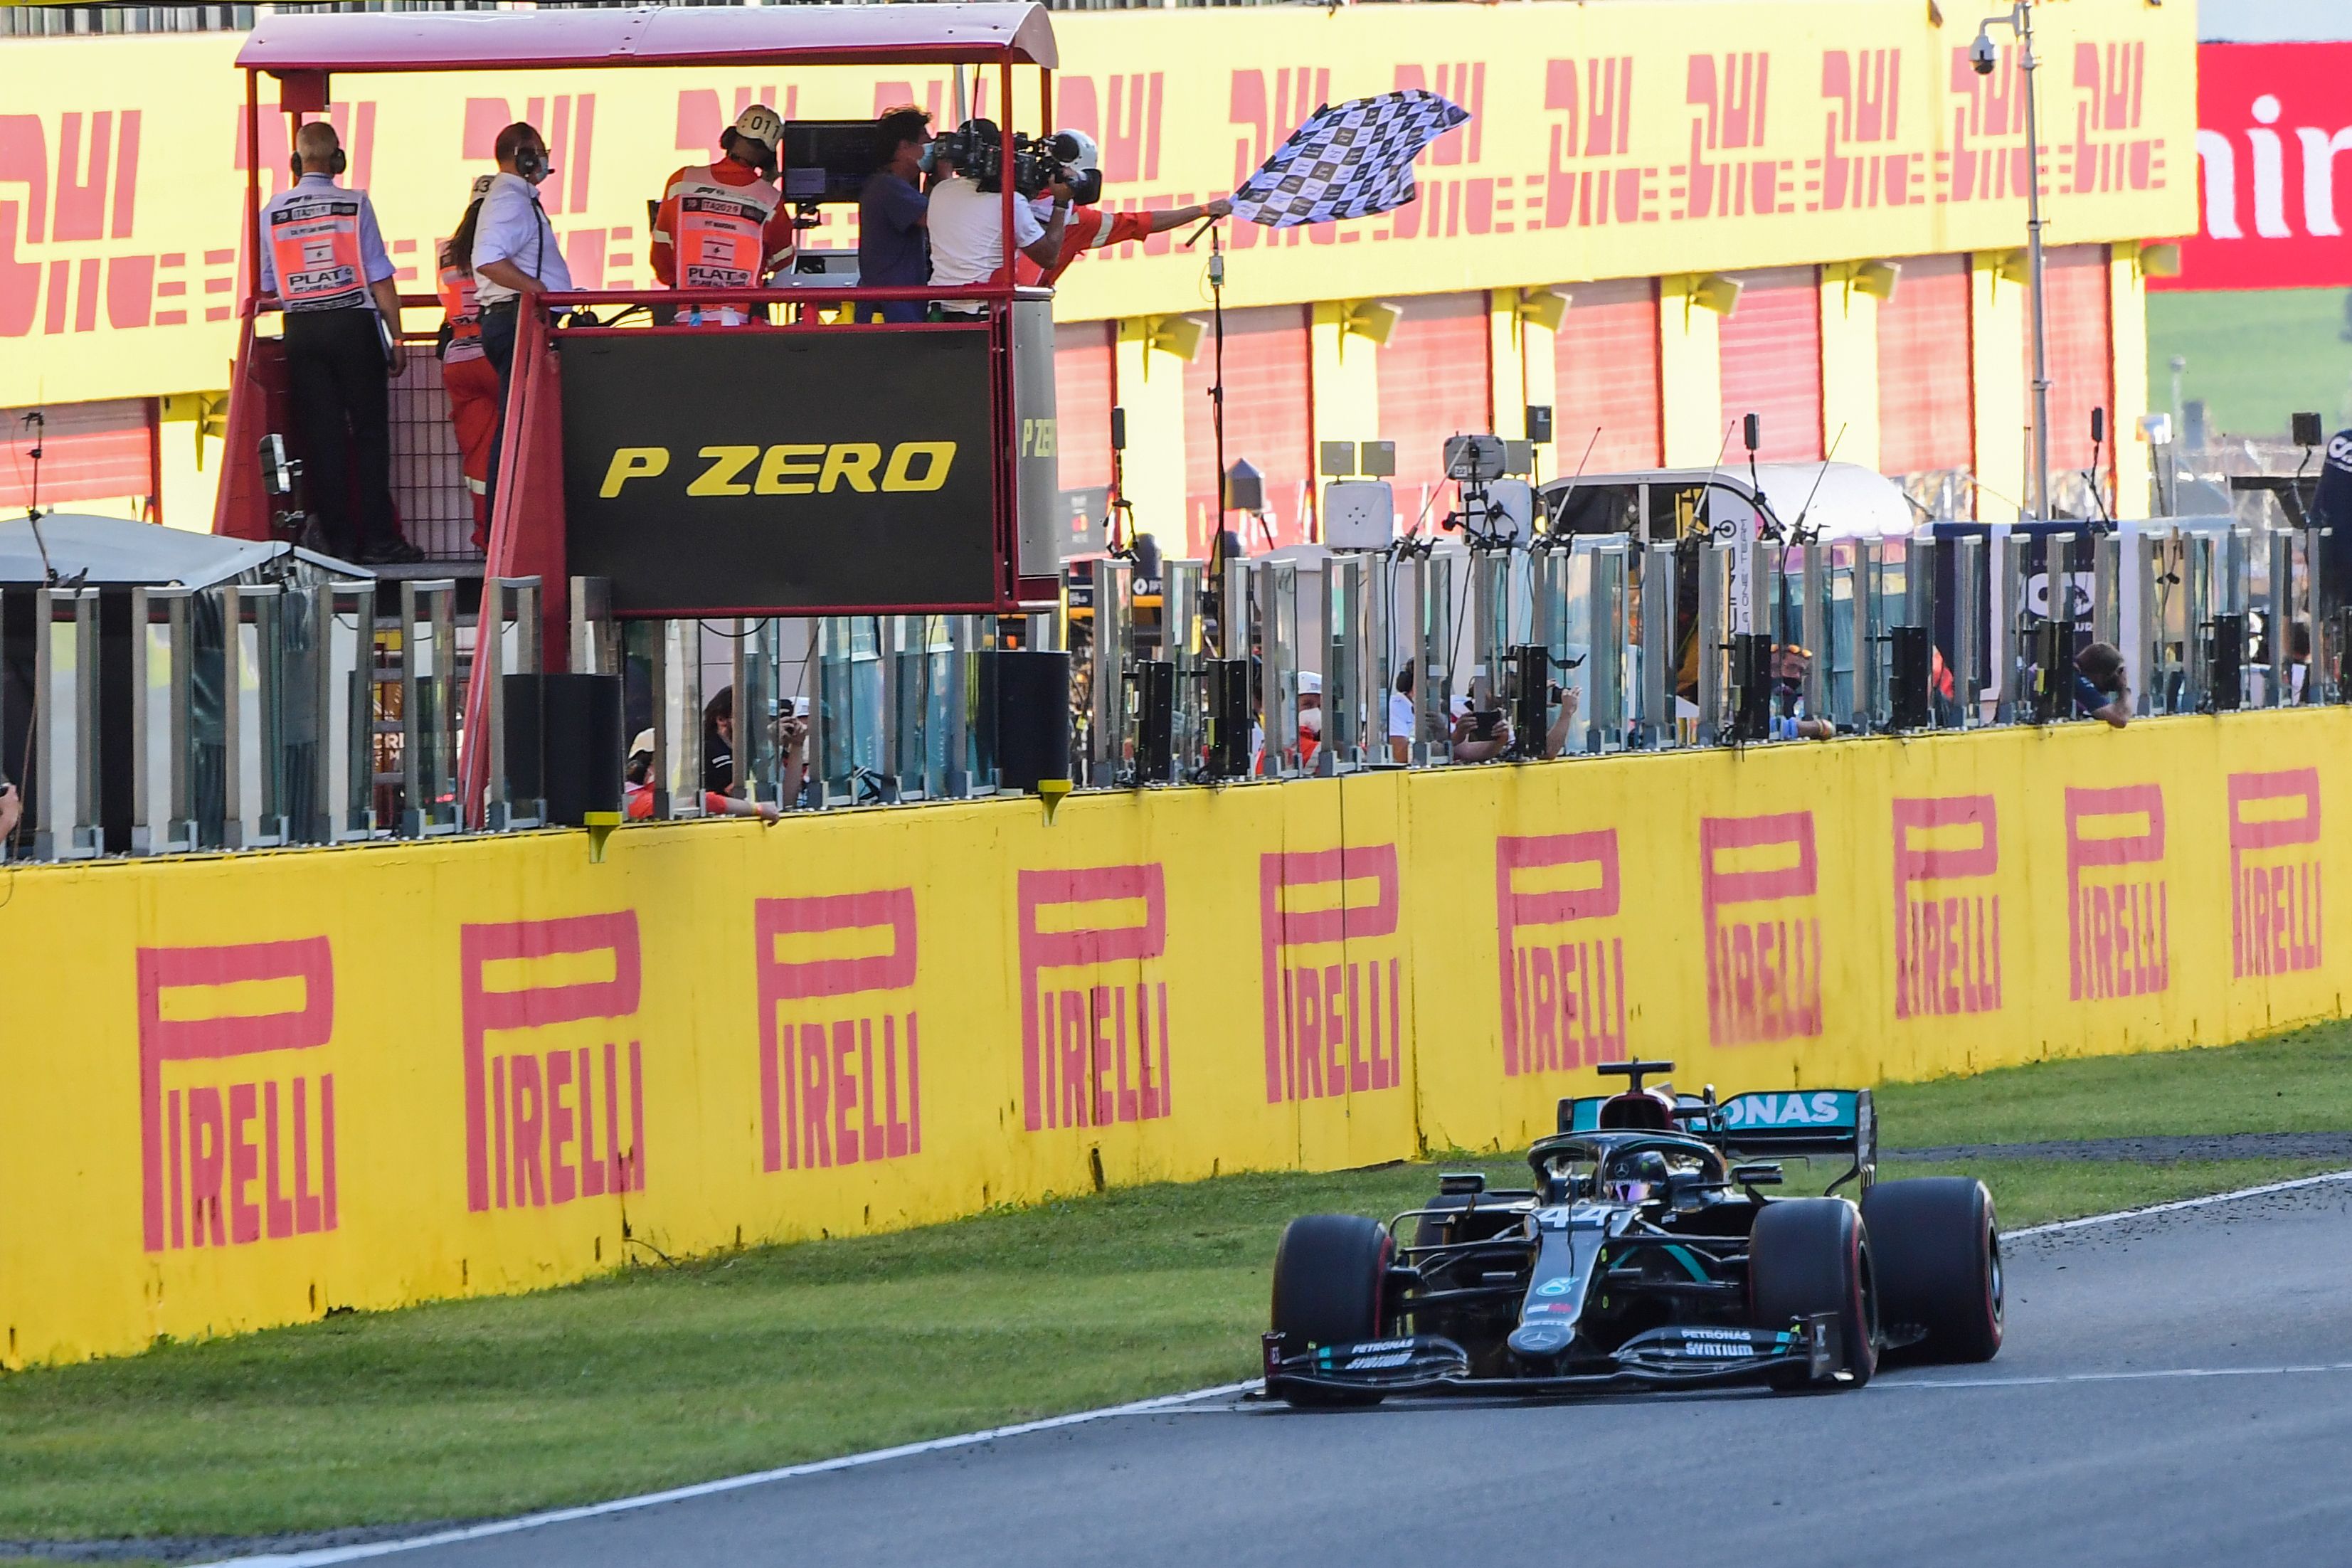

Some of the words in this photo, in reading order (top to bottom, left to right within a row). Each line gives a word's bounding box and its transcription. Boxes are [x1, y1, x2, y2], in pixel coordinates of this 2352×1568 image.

[751, 116, 780, 139] 011
[290, 269, 342, 286] PLAT
[689, 267, 737, 280] PLAT
[600, 447, 670, 498] P
[687, 442, 957, 497] ZERO
[1260, 843, 1400, 1103] PIRELLI
[1497, 828, 1625, 1076] PIRELLI
[1700, 810, 1823, 1047] PIRELLI
[1893, 794, 2001, 1019] PIRELLI
[2065, 783, 2168, 1000] PIRELLI
[2228, 768, 2321, 978] PIRELLI
[137, 936, 337, 1252] PIRELLI
[461, 909, 645, 1212] PIRELLI
[755, 887, 921, 1173] PIRELLI
[1017, 862, 1172, 1132] PIRELLI
[1537, 1205, 1612, 1228] 44
[1352, 1337, 1416, 1354] PETRONAS
[1681, 1330, 1752, 1341] PETRONAS
